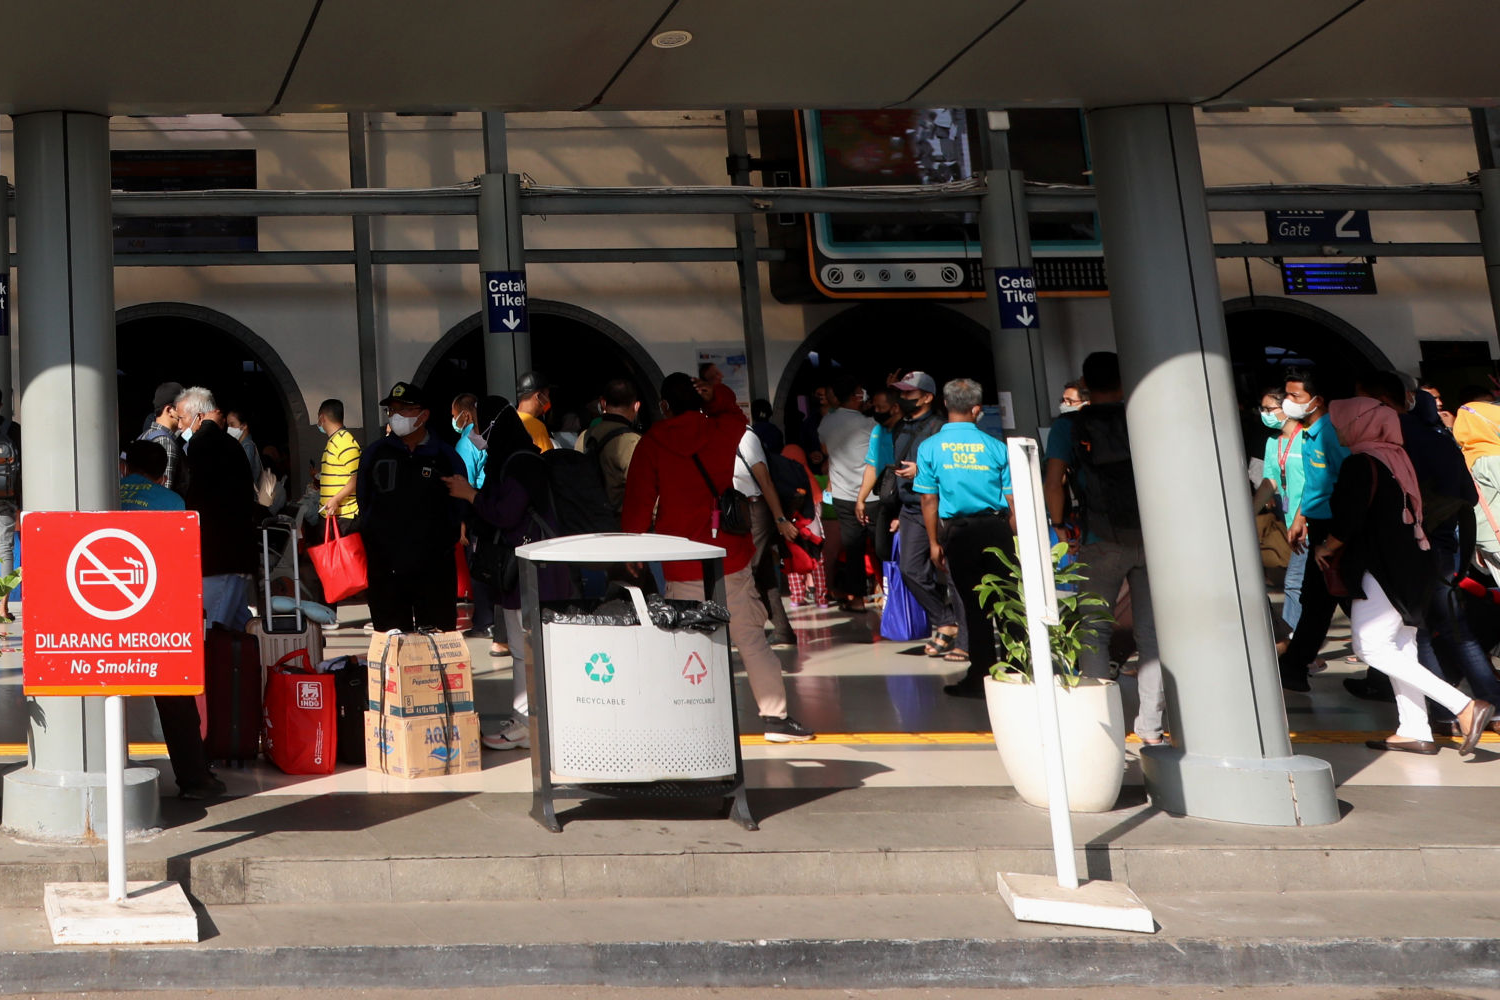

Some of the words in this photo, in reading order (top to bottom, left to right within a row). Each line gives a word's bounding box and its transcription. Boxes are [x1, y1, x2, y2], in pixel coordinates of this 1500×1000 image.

[1278, 221, 1312, 237] Gate
[488, 279, 526, 293] Cetak
[491, 293, 526, 307] Tiket
[941, 442, 986, 453] PORTER
[952, 452, 978, 464] 005
[35, 633, 113, 648] DILARANG
[118, 632, 192, 648] MEROKOK
[70, 659, 91, 674] No
[96, 658, 159, 678] Smoking
[576, 696, 627, 706] RECYCLABLE
[672, 697, 716, 706] NOT-RECYCLABLE
[424, 725, 461, 744] AQA
